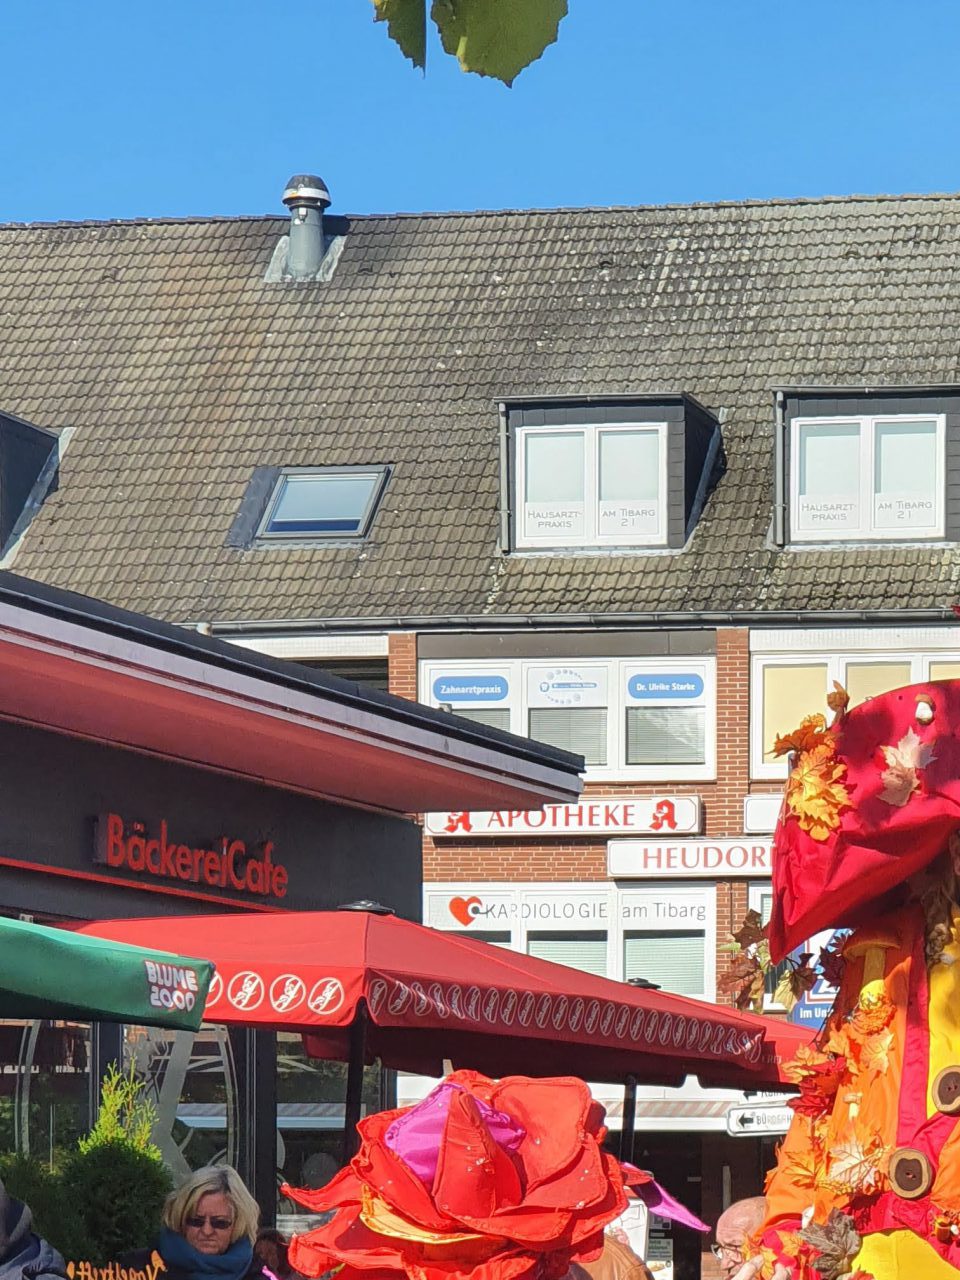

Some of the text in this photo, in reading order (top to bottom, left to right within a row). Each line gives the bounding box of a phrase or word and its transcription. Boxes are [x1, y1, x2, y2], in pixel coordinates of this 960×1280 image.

[878, 500, 933, 510] AM TIBARG
[602, 508, 656, 518] AM TIBARG
[812, 513, 847, 521] PRAXIS
[538, 520, 572, 528] PRAXIS
[440, 684, 502, 695] Zahnarztpraxis
[636, 682, 696, 691] Dr. Ulrike Starke
[487, 804, 635, 828] APOTHEKE
[485, 902, 706, 921] KARDIOLOGIE am Tibarg
[145, 960, 198, 992] BLUME
[150, 985, 195, 1012] 2000
